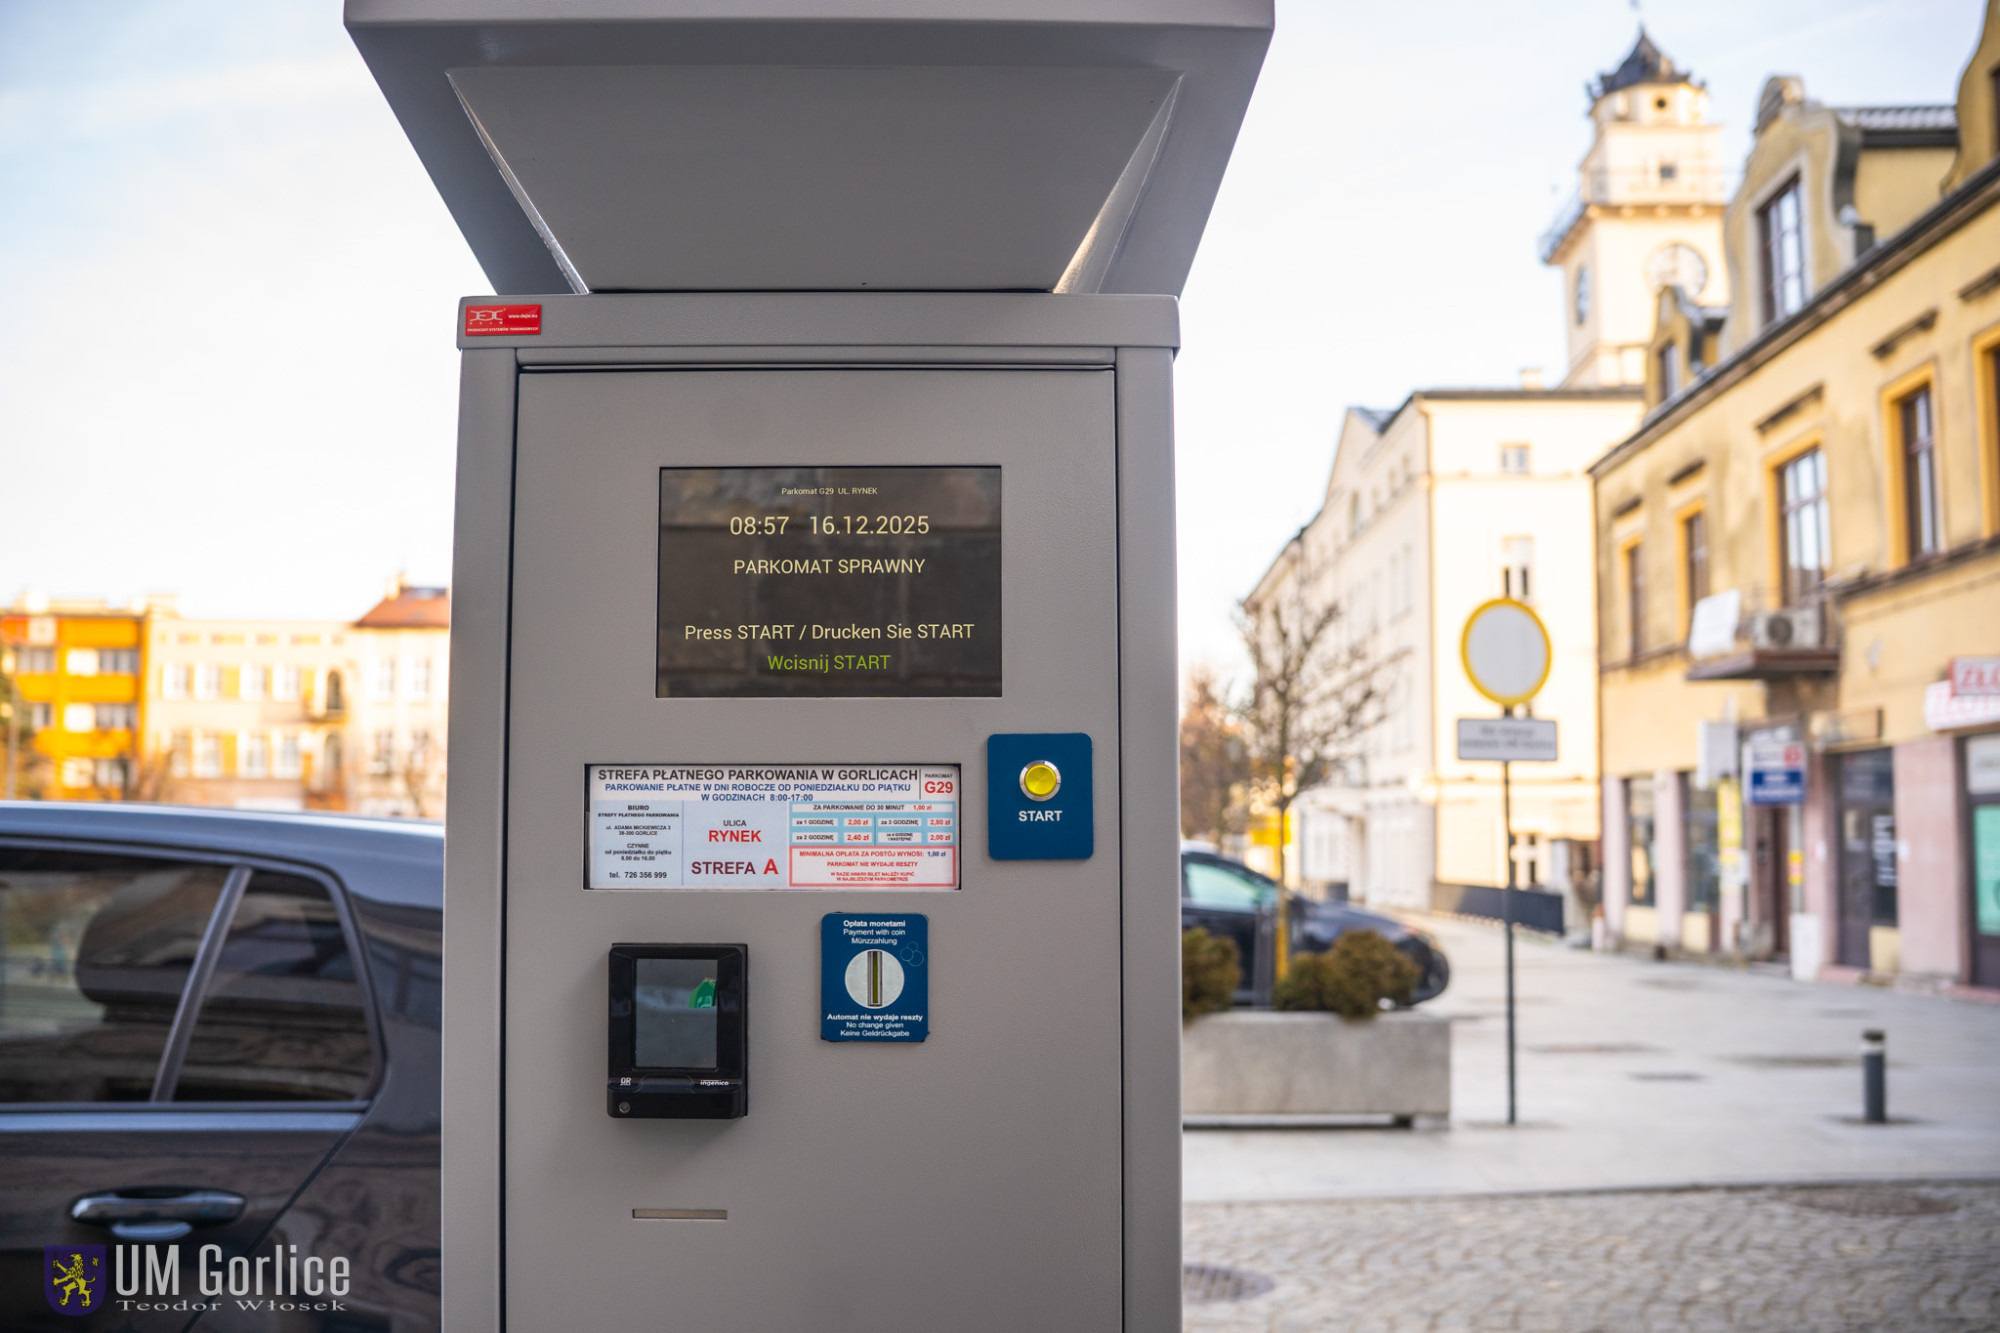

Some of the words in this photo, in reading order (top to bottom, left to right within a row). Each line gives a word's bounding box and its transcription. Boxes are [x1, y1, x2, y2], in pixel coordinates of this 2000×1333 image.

[781, 487, 817, 495] Parkomat
[730, 516, 789, 535] 08:57
[810, 516, 929, 535] 16.12.2025
[734, 559, 832, 574] PARKOMAT
[838, 559, 925, 574] SPRAWNY
[685, 625, 732, 640] Press
[738, 625, 794, 640] START
[799, 625, 806, 641] /
[812, 624, 881, 639] Drucken
[887, 624, 913, 639] Sie
[917, 624, 974, 638] START
[767, 655, 829, 673] Wcisnij
[834, 655, 891, 670] START
[598, 770, 649, 780] STREFA
[653, 770, 724, 780] PŁATNEGO
[728, 770, 818, 780] PARKOWANIA
[821, 770, 834, 780] W
[838, 770, 918, 780] GORLICACH
[878, 784, 910, 793] PIĄTKU
[925, 781, 953, 793] G29
[1018, 810, 1063, 821] START
[709, 830, 762, 842] RYNEK
[691, 862, 756, 874] STREFA
[763, 858, 779, 874] A
